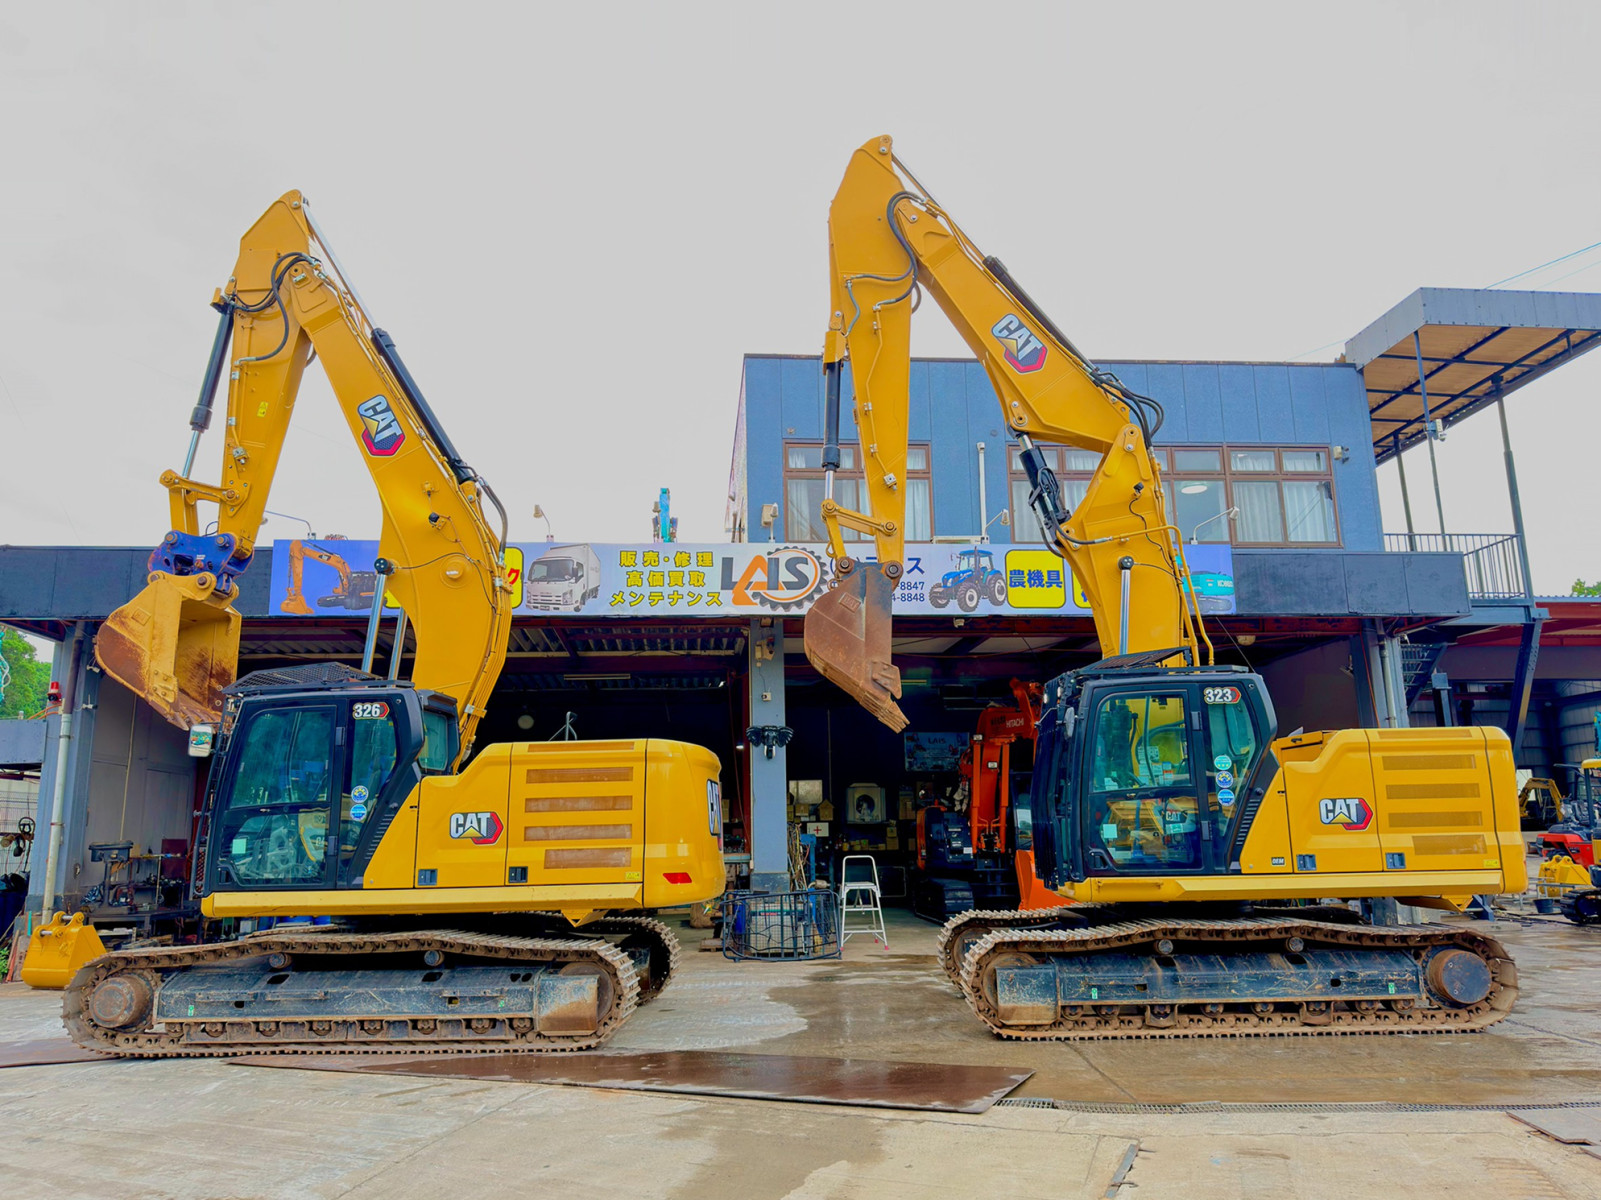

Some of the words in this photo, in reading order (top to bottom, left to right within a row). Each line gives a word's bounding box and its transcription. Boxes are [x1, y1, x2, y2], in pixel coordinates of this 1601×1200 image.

[992, 314, 1043, 360] CAT
[358, 395, 402, 443] CAT
[619, 550, 714, 567] 販売・修理
[626, 569, 706, 587] 高価買取
[720, 554, 809, 606] LAIS
[1009, 569, 1063, 589] 農機具
[609, 591, 723, 607] メンテナンス
[1205, 688, 1232, 702] 323
[354, 703, 381, 718] 326
[1319, 798, 1360, 825] CAT
[450, 812, 491, 839] CAT
